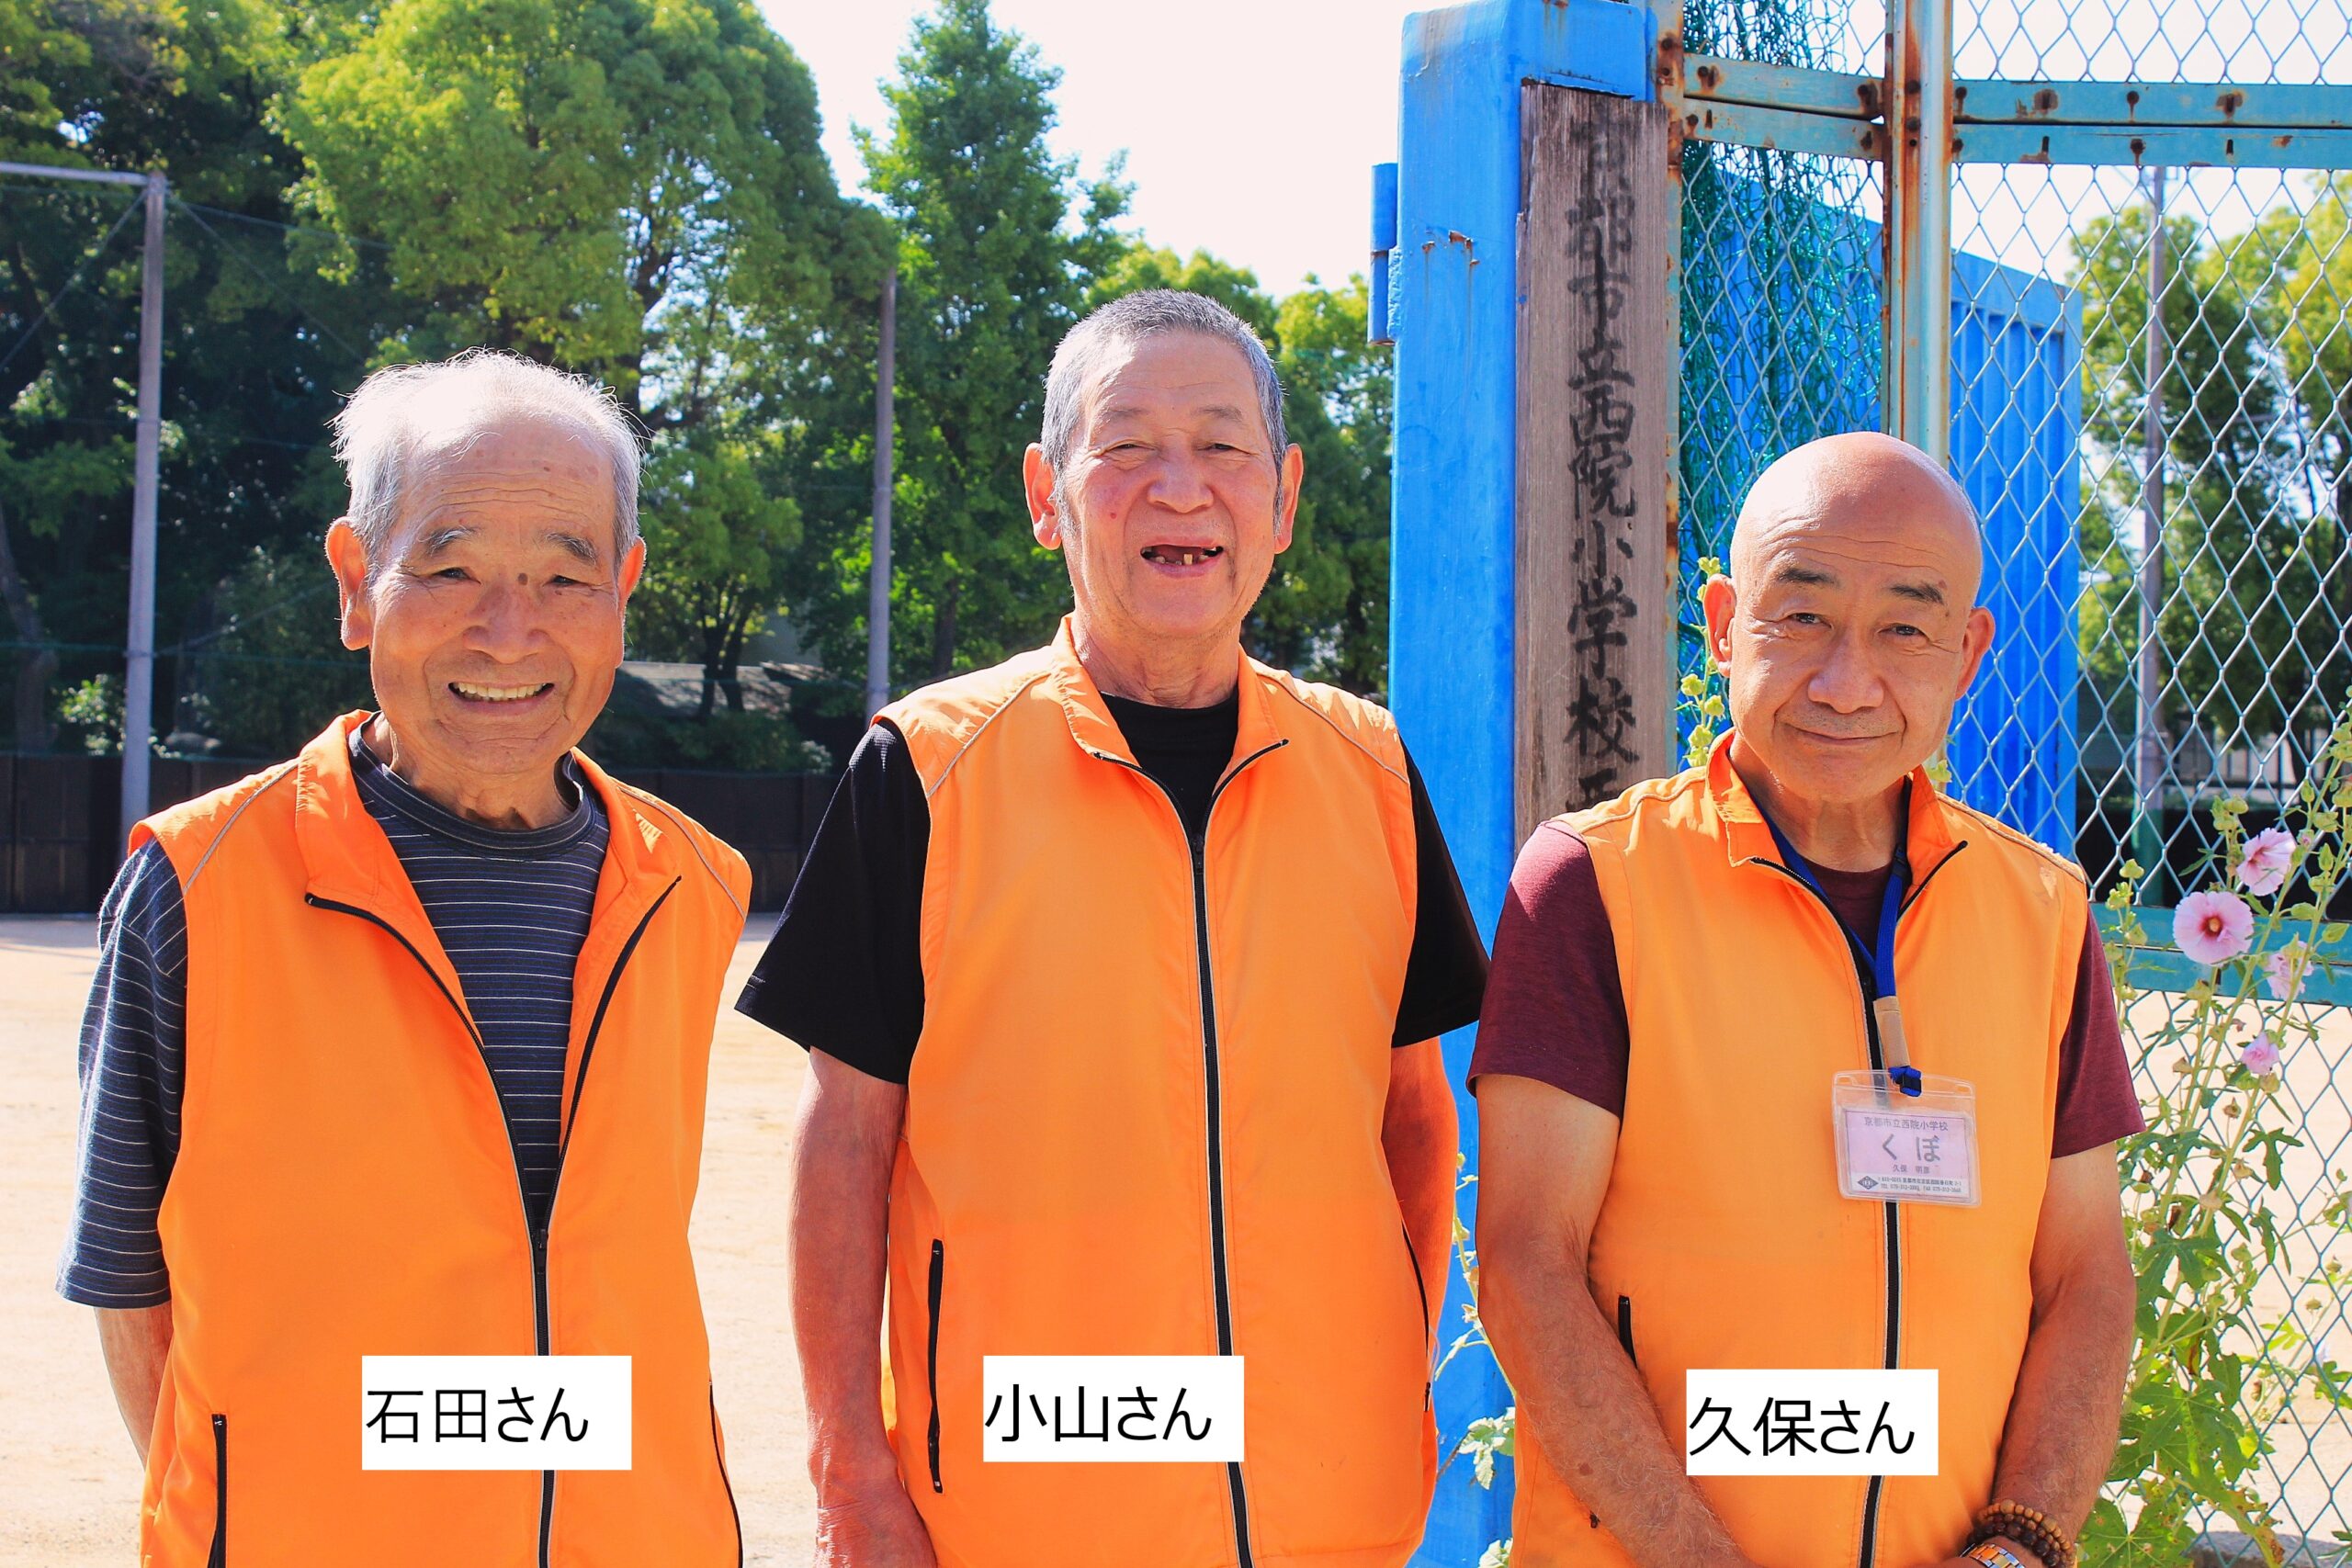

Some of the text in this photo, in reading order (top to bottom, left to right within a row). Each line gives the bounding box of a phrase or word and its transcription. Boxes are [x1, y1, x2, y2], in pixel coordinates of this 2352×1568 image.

[1863, 1116, 1949, 1132] 京都市立西院小学校
